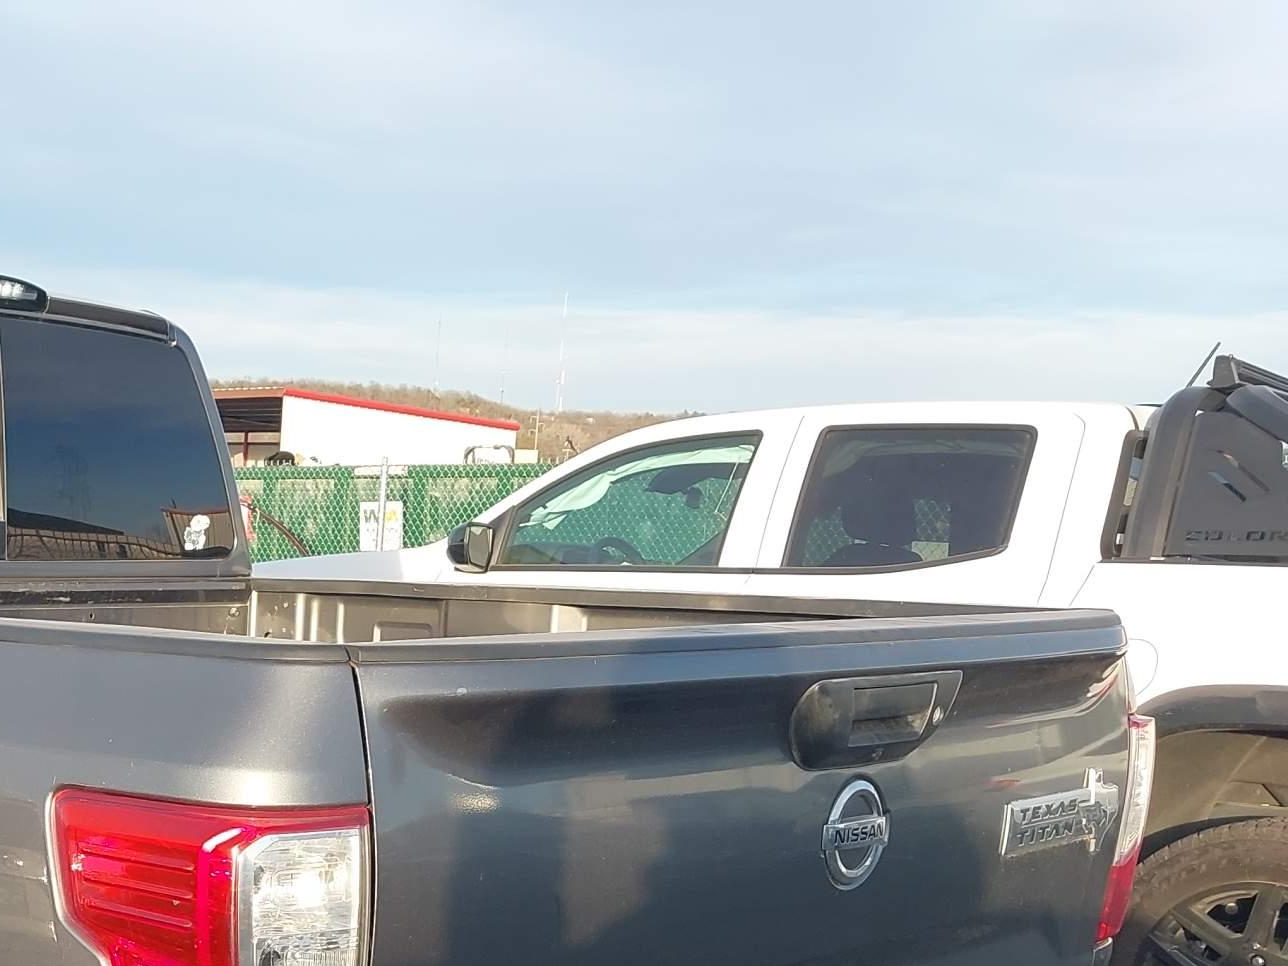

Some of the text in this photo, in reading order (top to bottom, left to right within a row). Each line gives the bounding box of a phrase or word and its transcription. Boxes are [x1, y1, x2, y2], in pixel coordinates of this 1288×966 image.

[1020, 798, 1080, 824] TEXAS
[834, 820, 885, 845] NISSAN
[1016, 820, 1076, 847] TITAN
